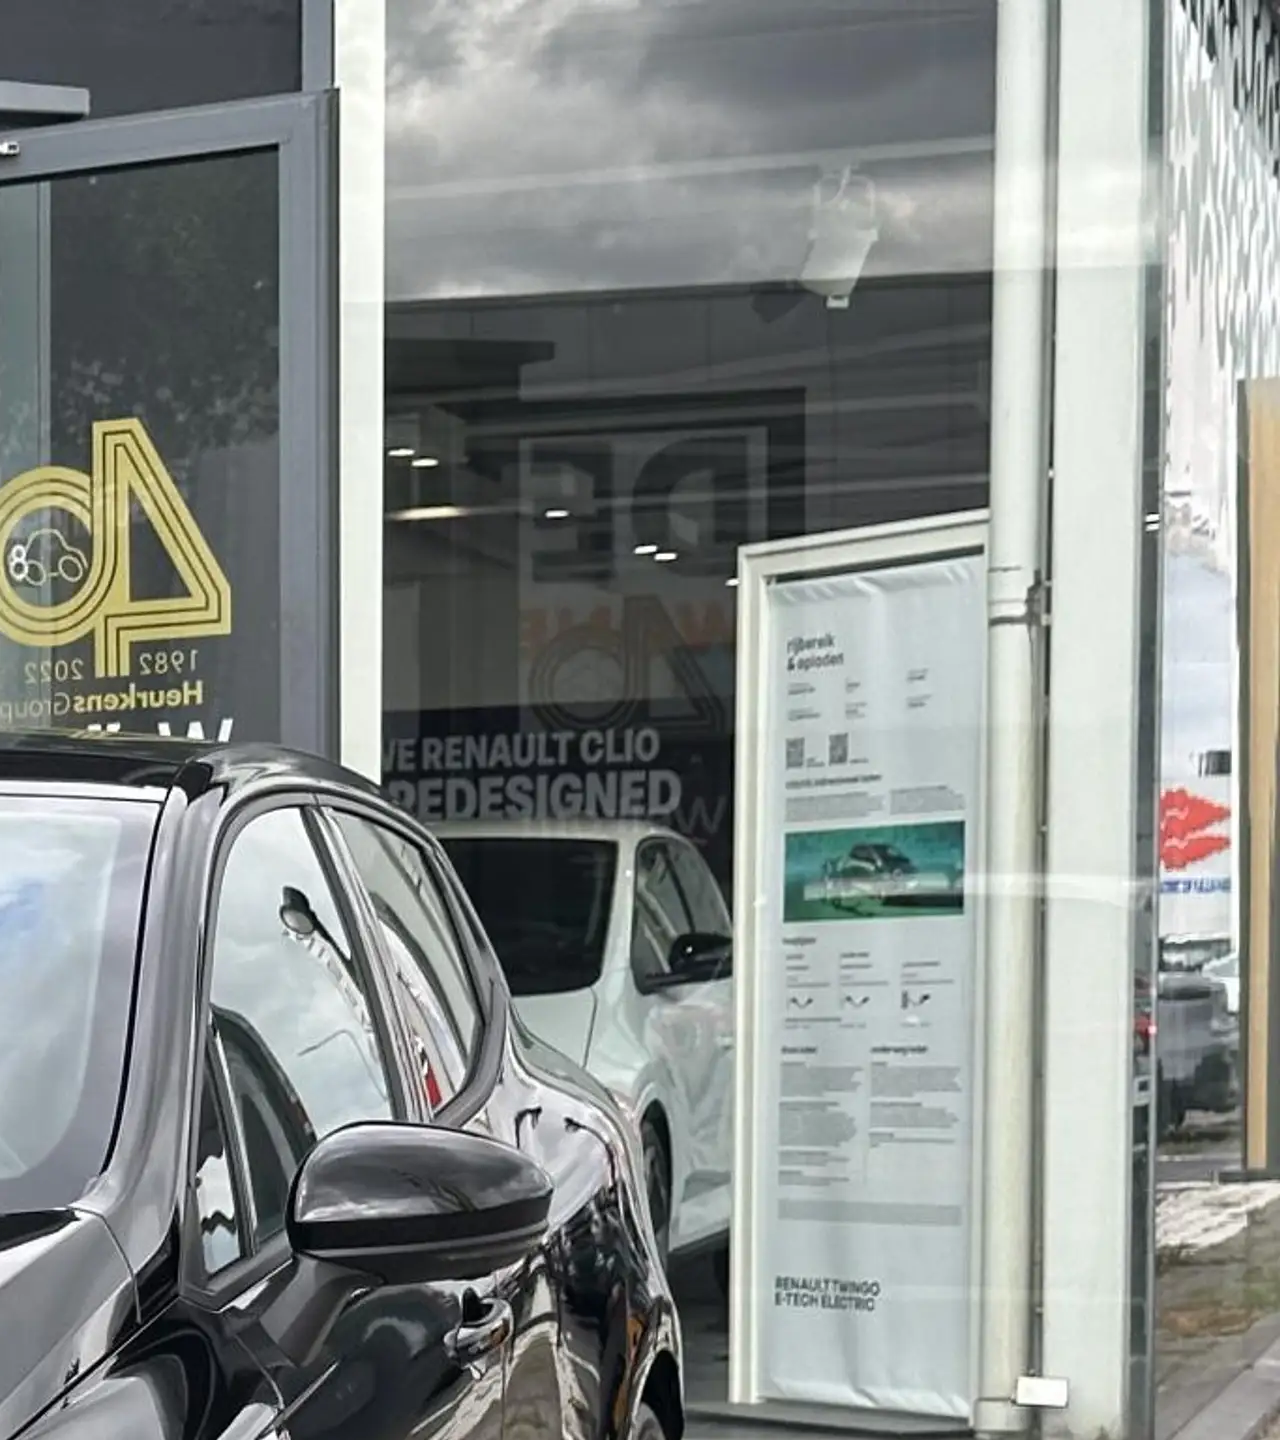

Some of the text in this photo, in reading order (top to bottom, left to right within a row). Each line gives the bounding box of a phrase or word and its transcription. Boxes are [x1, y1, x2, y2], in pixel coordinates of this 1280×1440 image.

[422, 730, 576, 770] RENAULT
[579, 727, 661, 765] CLIO
[389, 768, 683, 821] REDESIGNED
[774, 1275, 881, 1297] RENAULT TWINGO
[774, 1292, 876, 1312] E-TECH ELECTRIC
